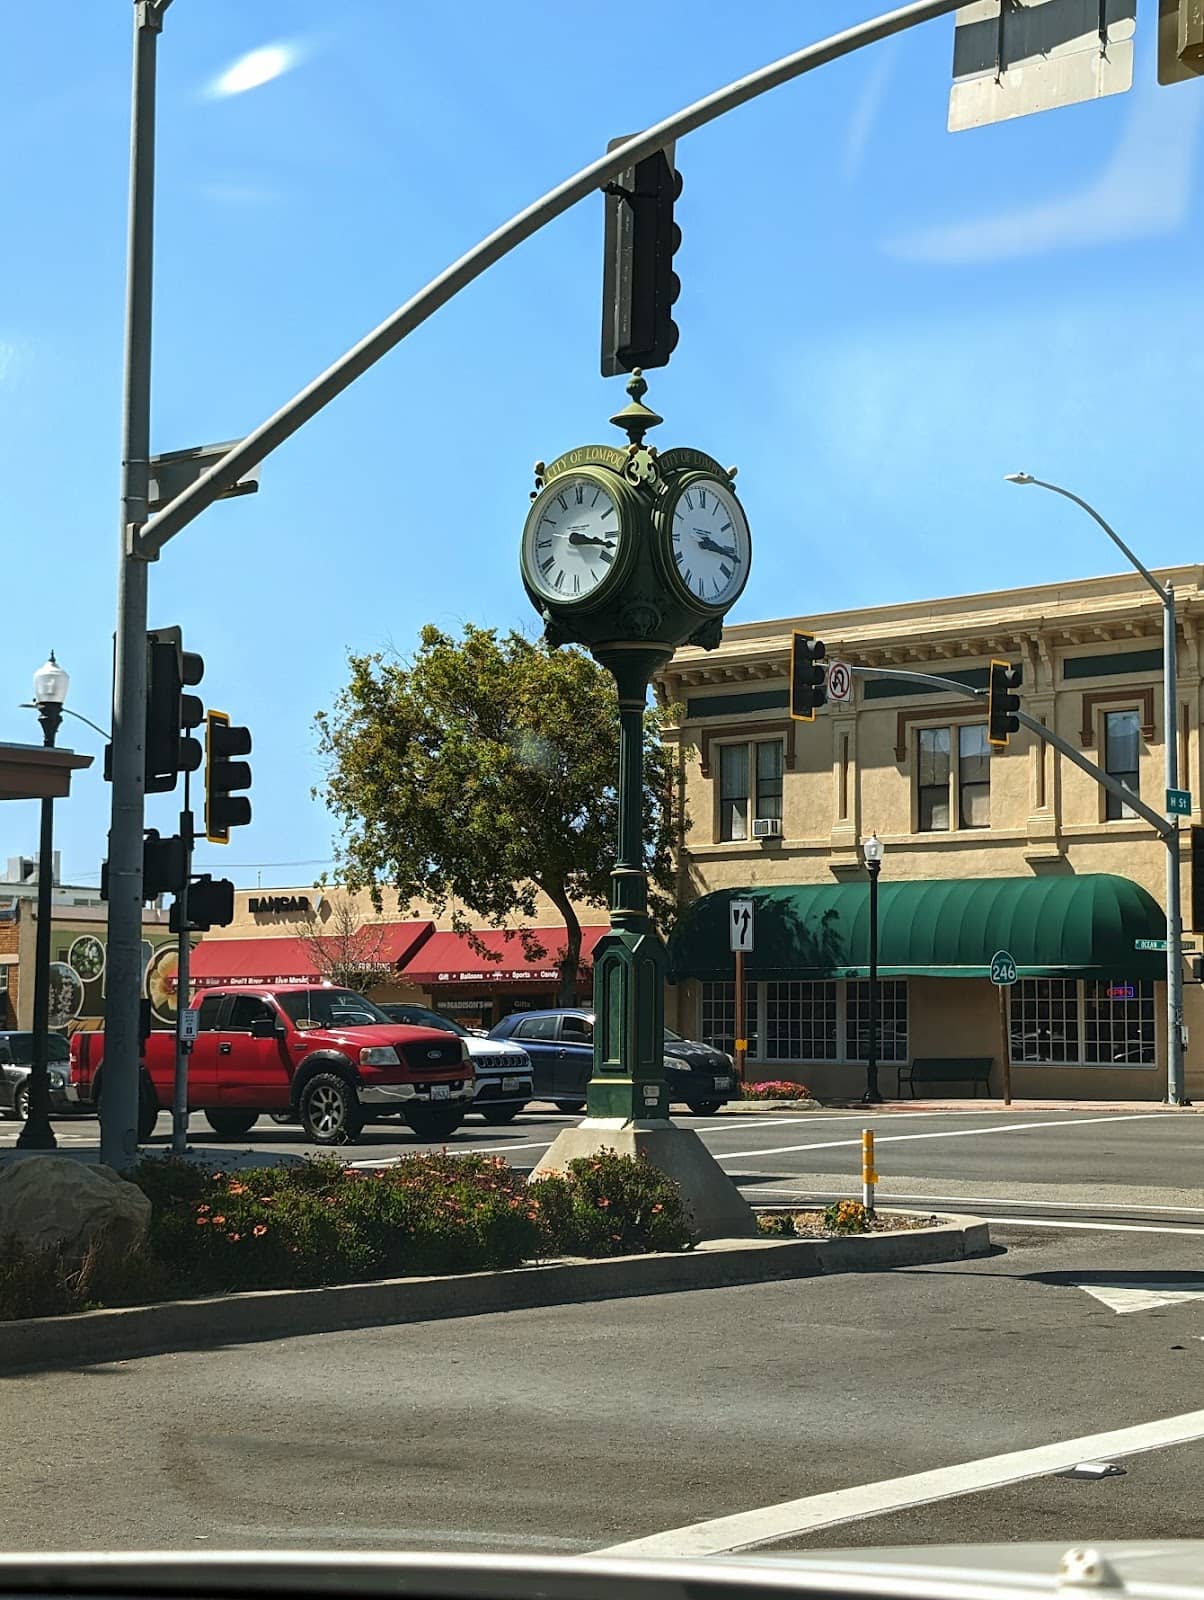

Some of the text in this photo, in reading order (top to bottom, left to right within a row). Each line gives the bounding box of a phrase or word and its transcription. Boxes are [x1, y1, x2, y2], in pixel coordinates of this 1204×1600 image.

[547, 448, 626, 479] CITY OF LOMPOC
[1170, 796, 1187, 809] H St
[1140, 940, 1158, 950] OCEAN
[512, 970, 531, 979] Sports
[540, 969, 559, 979] Candy
[992, 964, 1016, 981] 246
